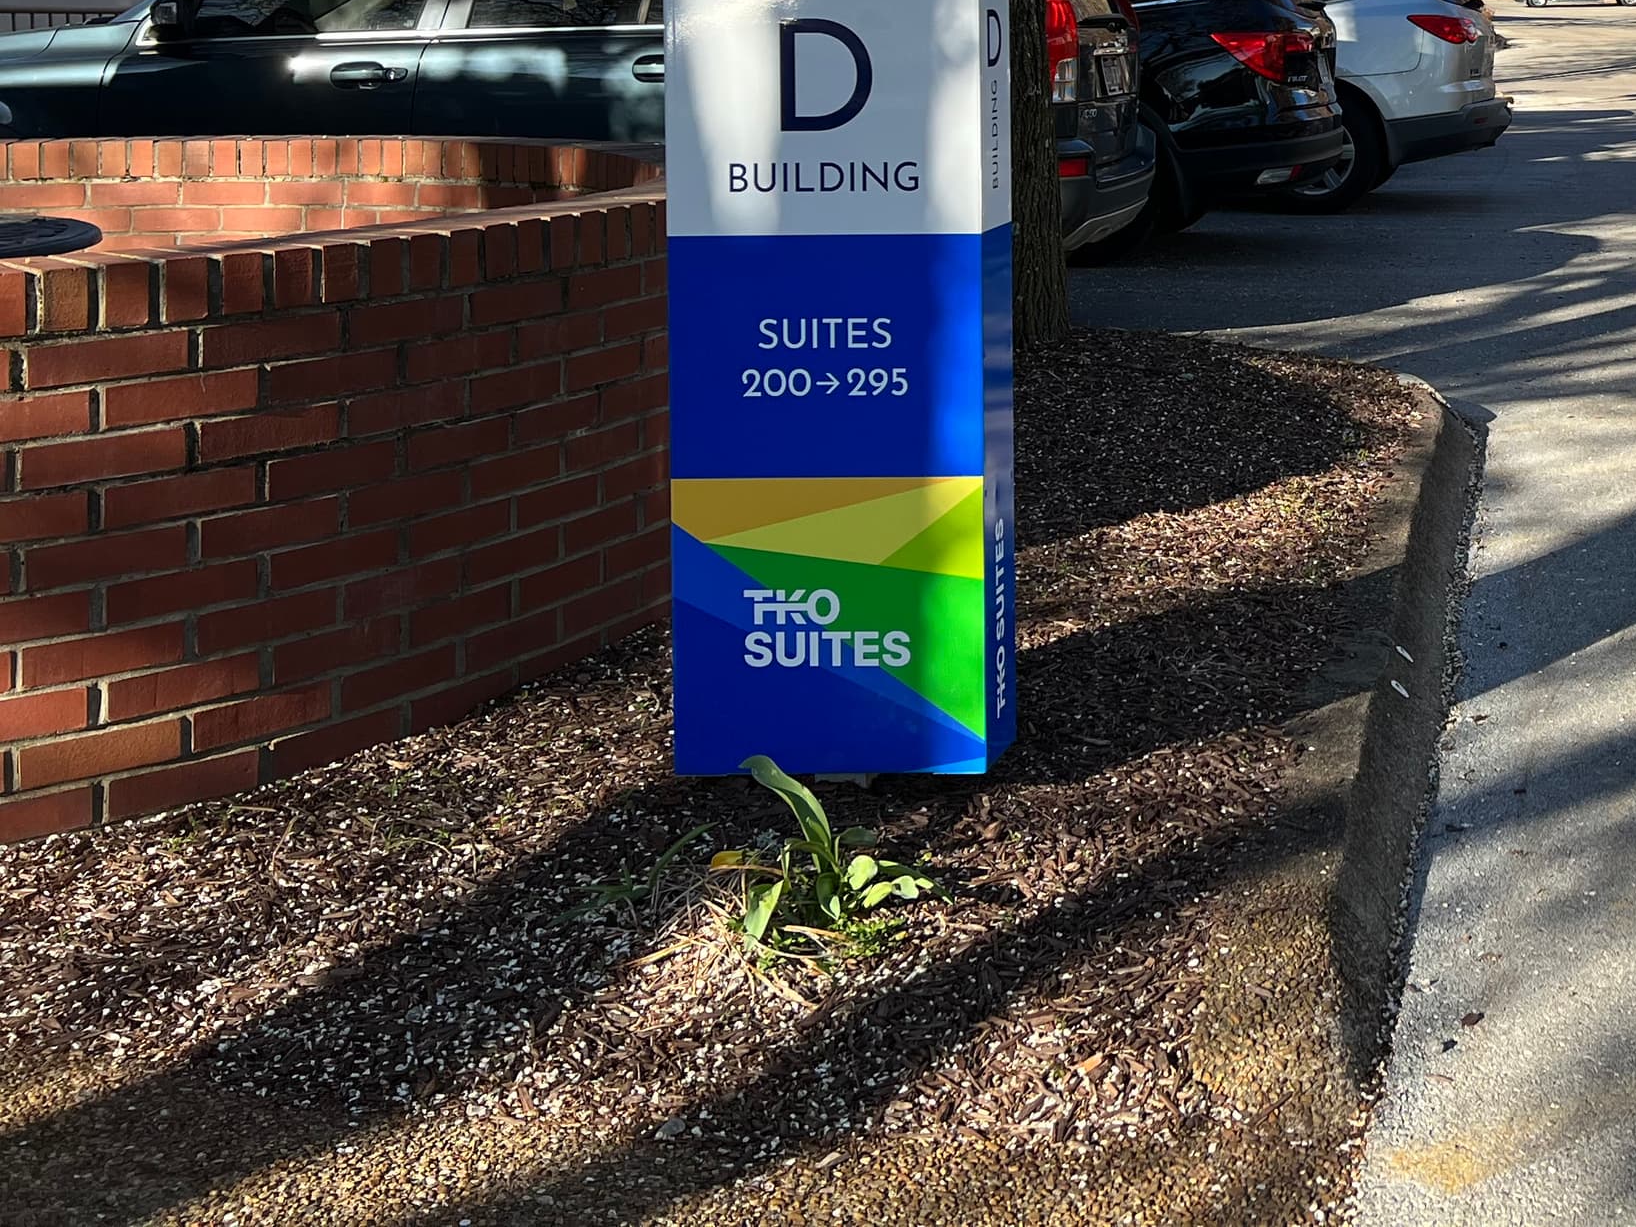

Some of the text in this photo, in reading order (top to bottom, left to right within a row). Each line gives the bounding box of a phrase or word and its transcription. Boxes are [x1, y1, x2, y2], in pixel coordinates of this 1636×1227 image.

[986, 8, 1002, 68] D
[779, 18, 873, 132] D
[991, 79, 1000, 190] BUILDING
[729, 161, 920, 193] BUILDING
[758, 317, 891, 349] SUITES
[742, 368, 908, 397] 200 295
[743, 589, 840, 625] TKO
[995, 517, 1006, 719] TKO SUITES
[744, 630, 911, 667] SUITES
